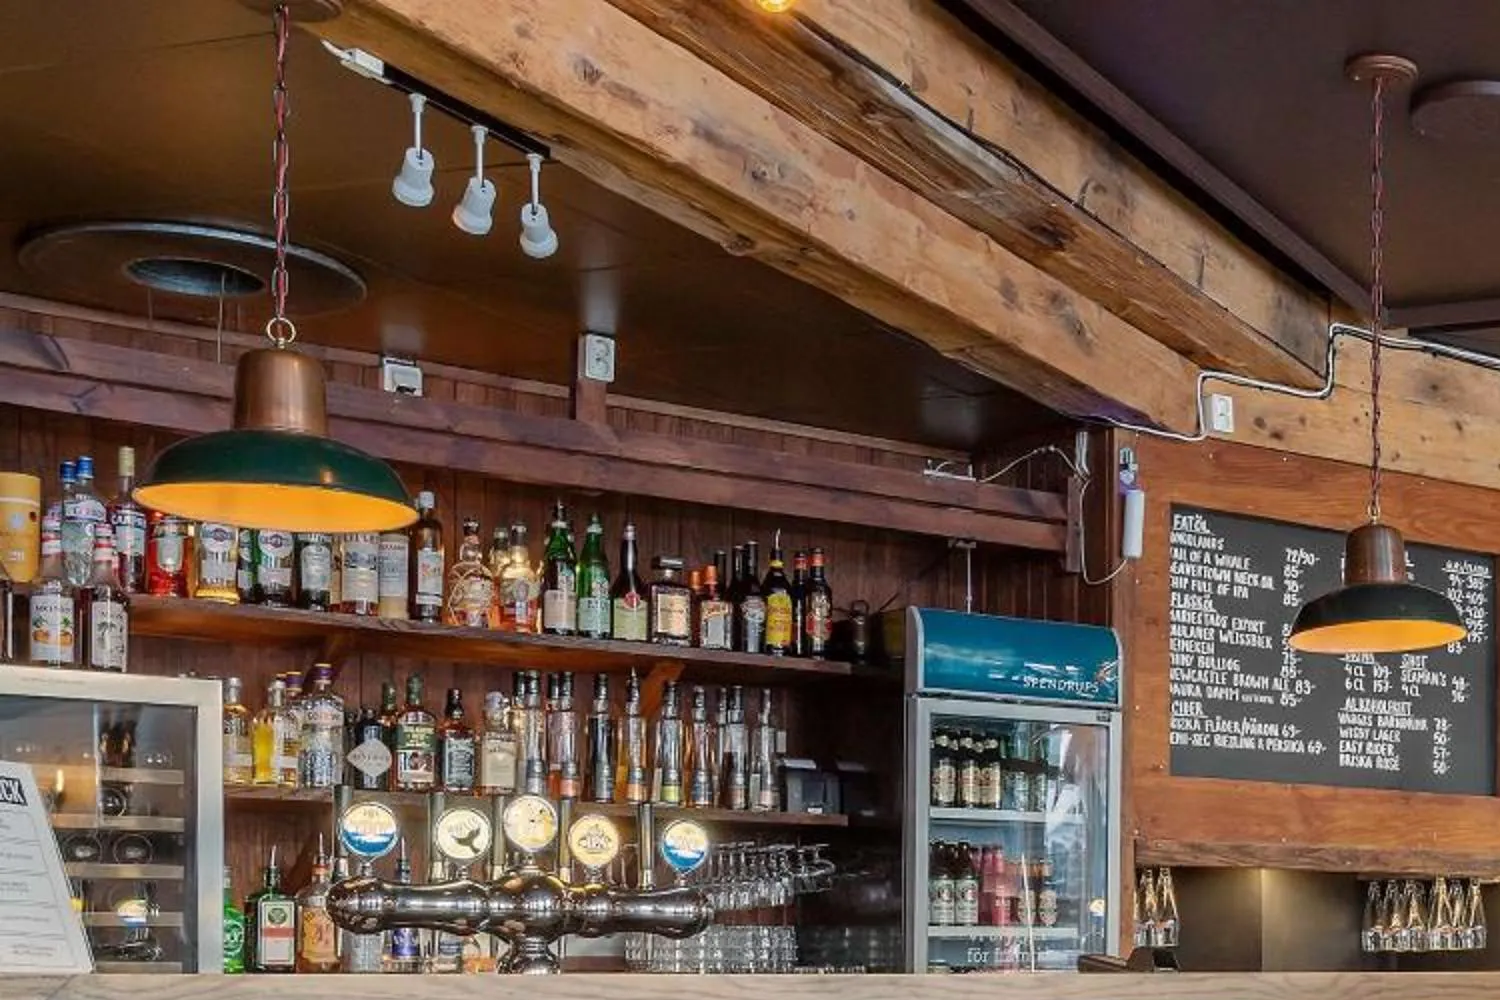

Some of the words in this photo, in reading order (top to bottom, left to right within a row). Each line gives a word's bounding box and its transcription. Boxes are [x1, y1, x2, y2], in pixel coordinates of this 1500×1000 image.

[1189, 551, 1200, 563] OF
[1203, 552, 1212, 565] A
[1215, 553, 1251, 570] WHALE
[1170, 576, 1189, 591] HIP
[1022, 675, 1099, 693] SPENDRUPS
[1170, 682, 1202, 698] AURA
